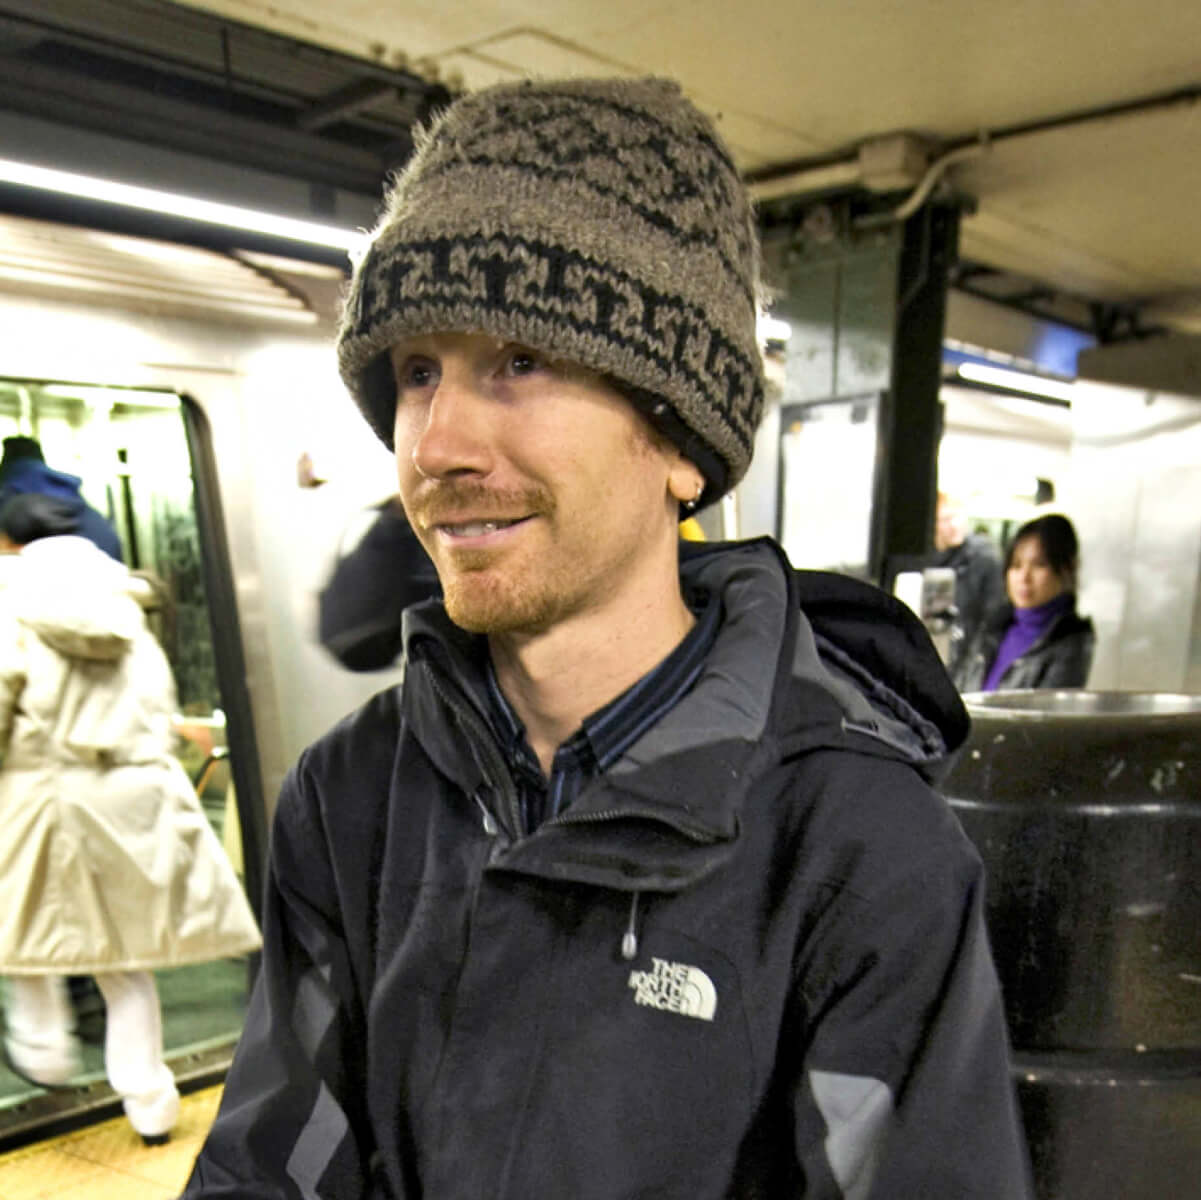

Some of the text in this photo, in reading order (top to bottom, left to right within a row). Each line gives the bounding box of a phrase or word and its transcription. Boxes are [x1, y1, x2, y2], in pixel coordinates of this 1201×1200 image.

[651, 956, 688, 981] THE
[627, 969, 684, 998] NORTH
[634, 989, 681, 1012] FACE
